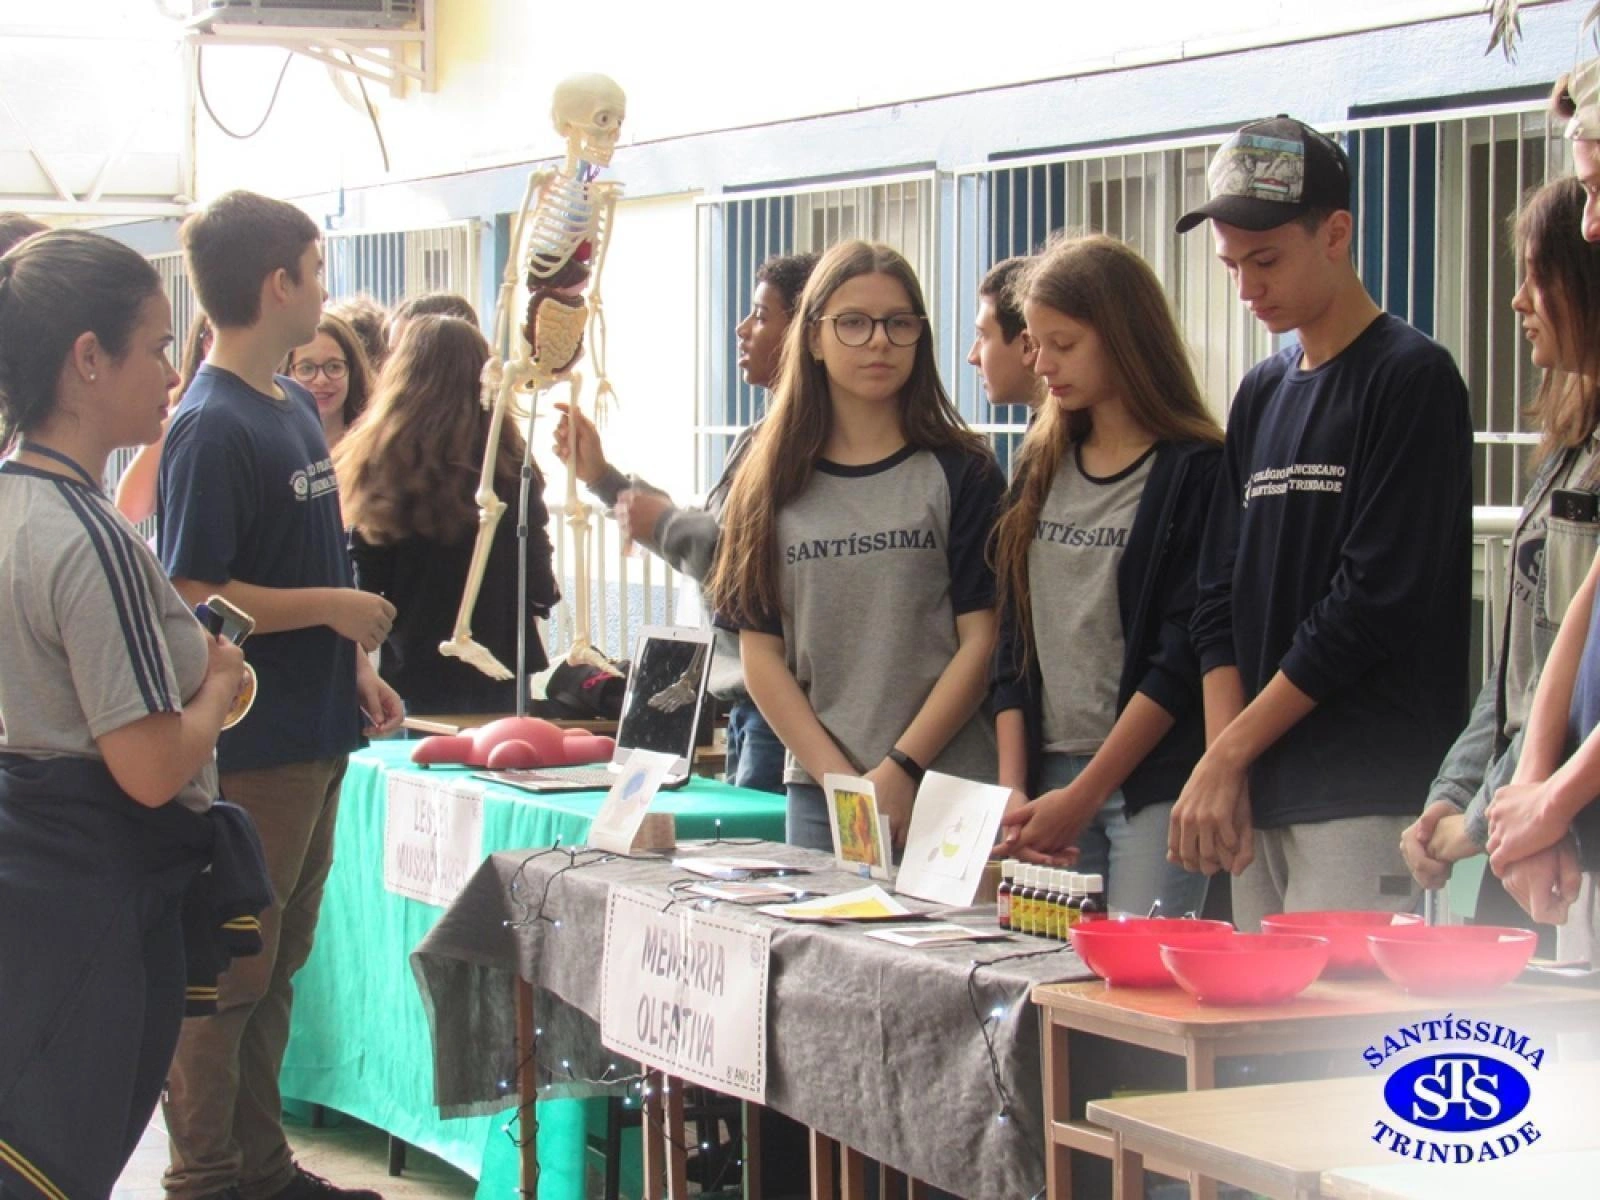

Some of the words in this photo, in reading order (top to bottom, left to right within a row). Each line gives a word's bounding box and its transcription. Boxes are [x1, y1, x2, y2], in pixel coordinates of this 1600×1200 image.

[787, 529, 937, 565] SANTÍSSIMA
[1033, 519, 1129, 548] NTÍSSIM
[637, 992, 715, 1068] OLFATIVA
